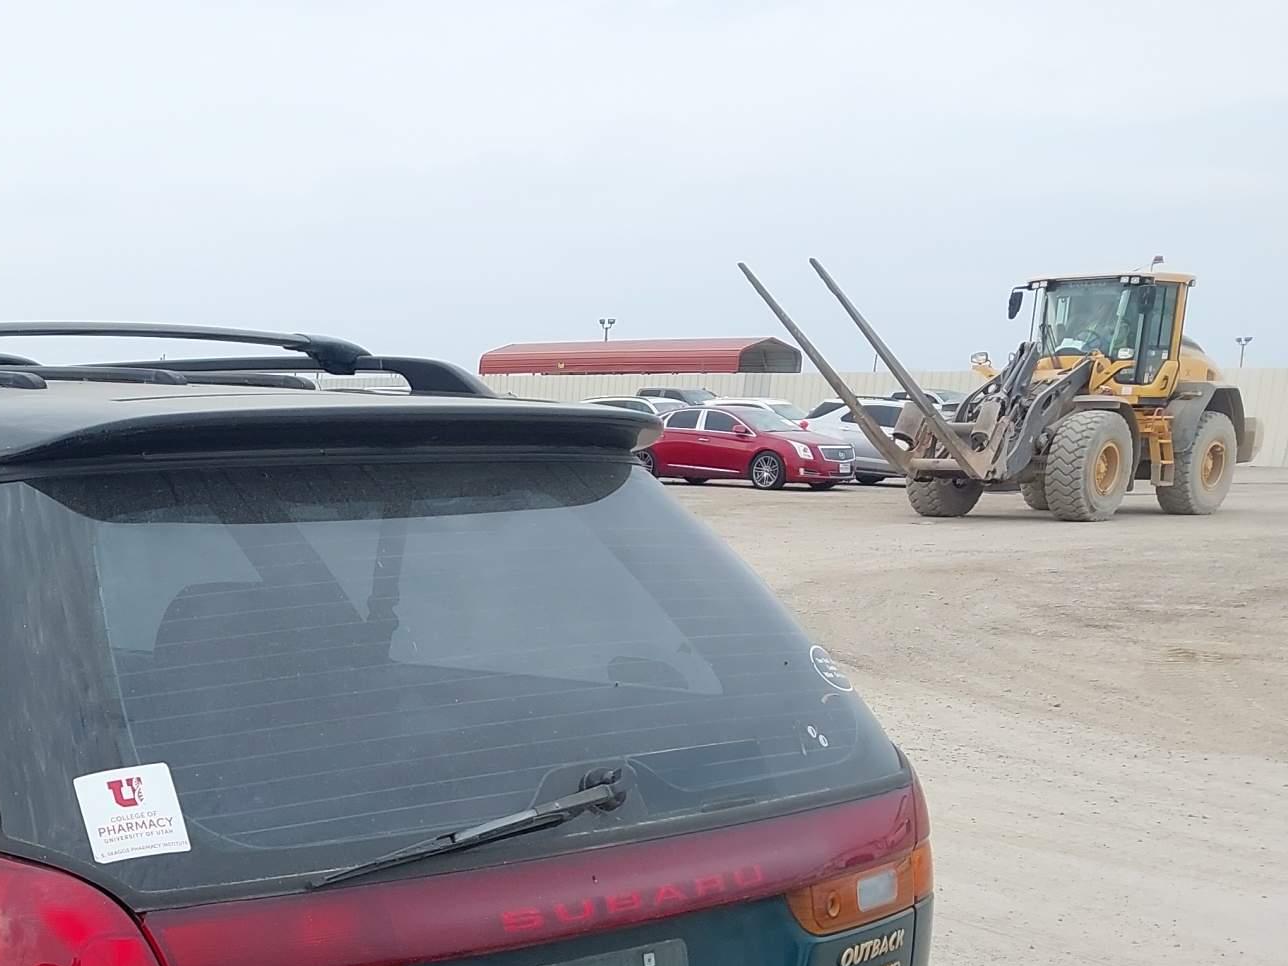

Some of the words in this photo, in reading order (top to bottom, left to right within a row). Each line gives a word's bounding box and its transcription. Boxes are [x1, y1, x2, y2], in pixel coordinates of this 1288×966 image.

[110, 812, 146, 823] COLLEGE
[98, 816, 174, 838] PHARMACY
[103, 832, 144, 845] UNIVERSITY
[500, 864, 764, 932] SUBARU
